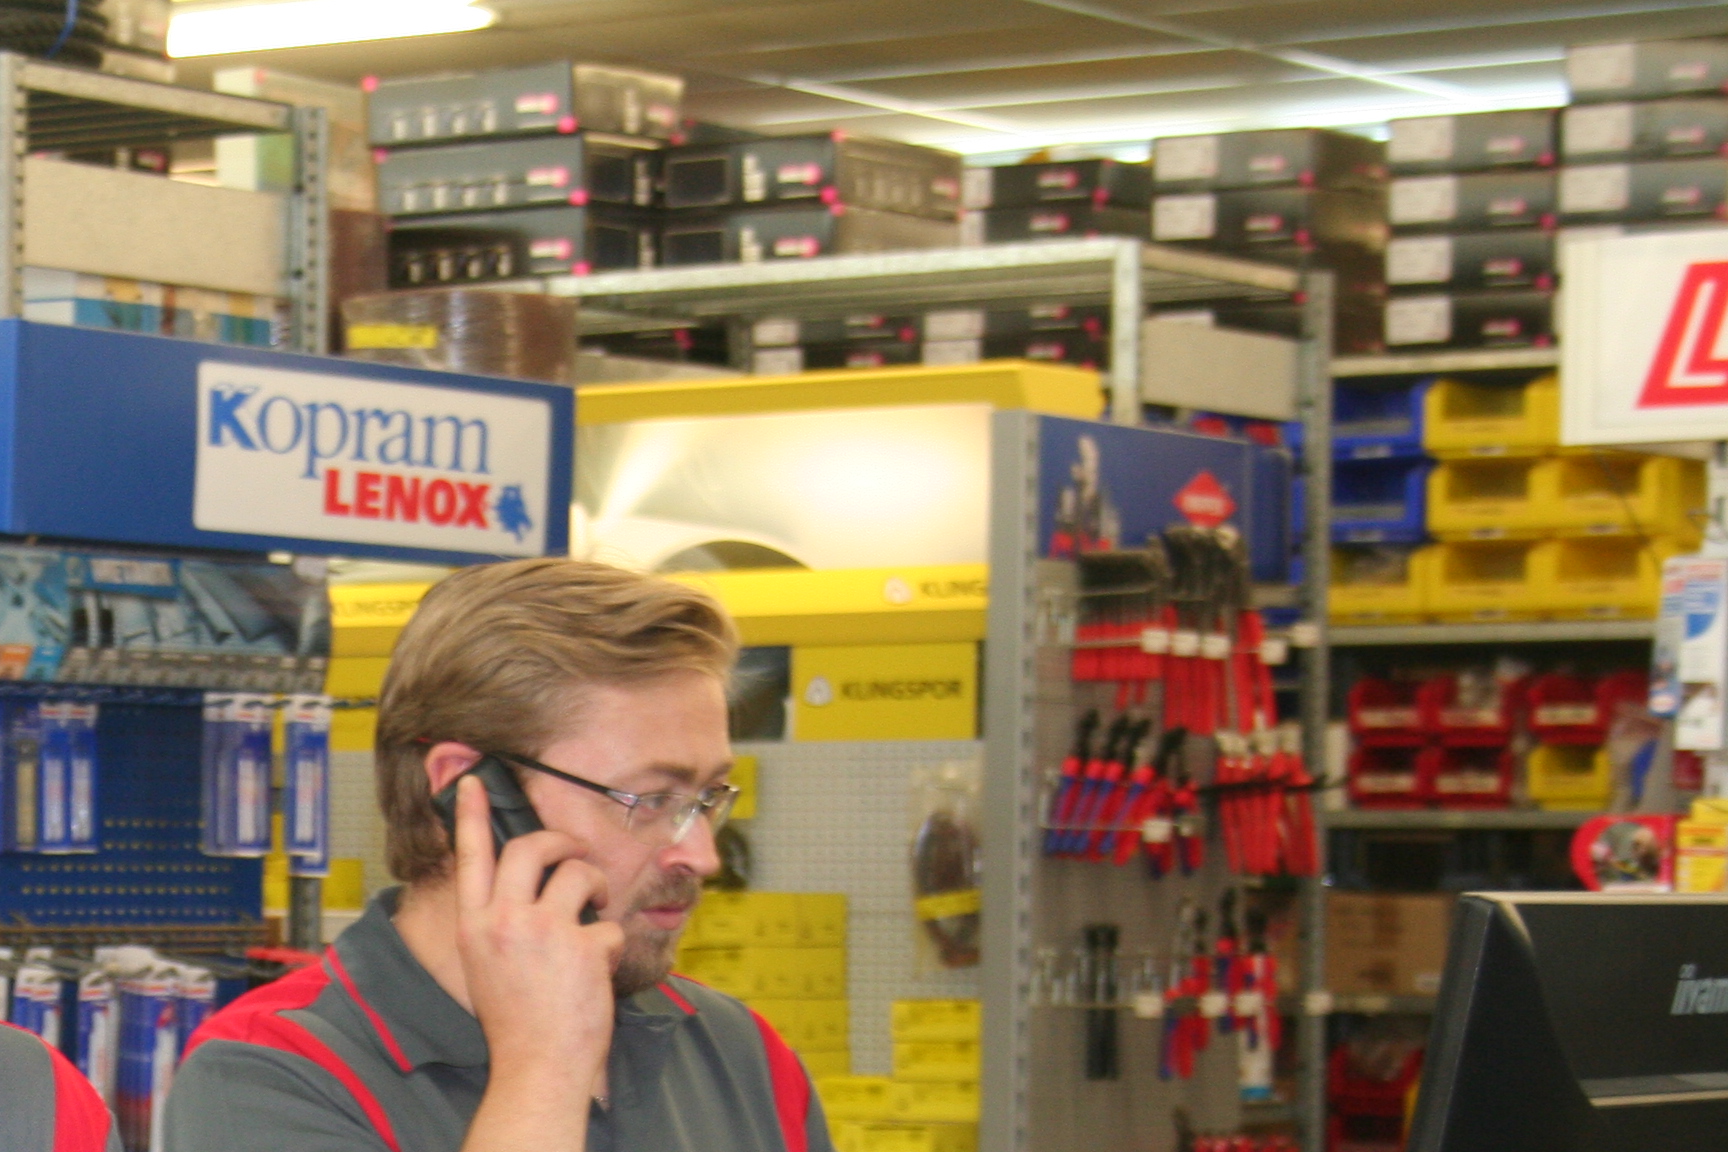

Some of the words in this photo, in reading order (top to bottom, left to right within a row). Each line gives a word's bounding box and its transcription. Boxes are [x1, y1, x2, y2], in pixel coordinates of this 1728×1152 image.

[208, 383, 491, 480] Kopram
[322, 467, 492, 530] LENOX
[841, 679, 963, 701] KLINGSPOR
